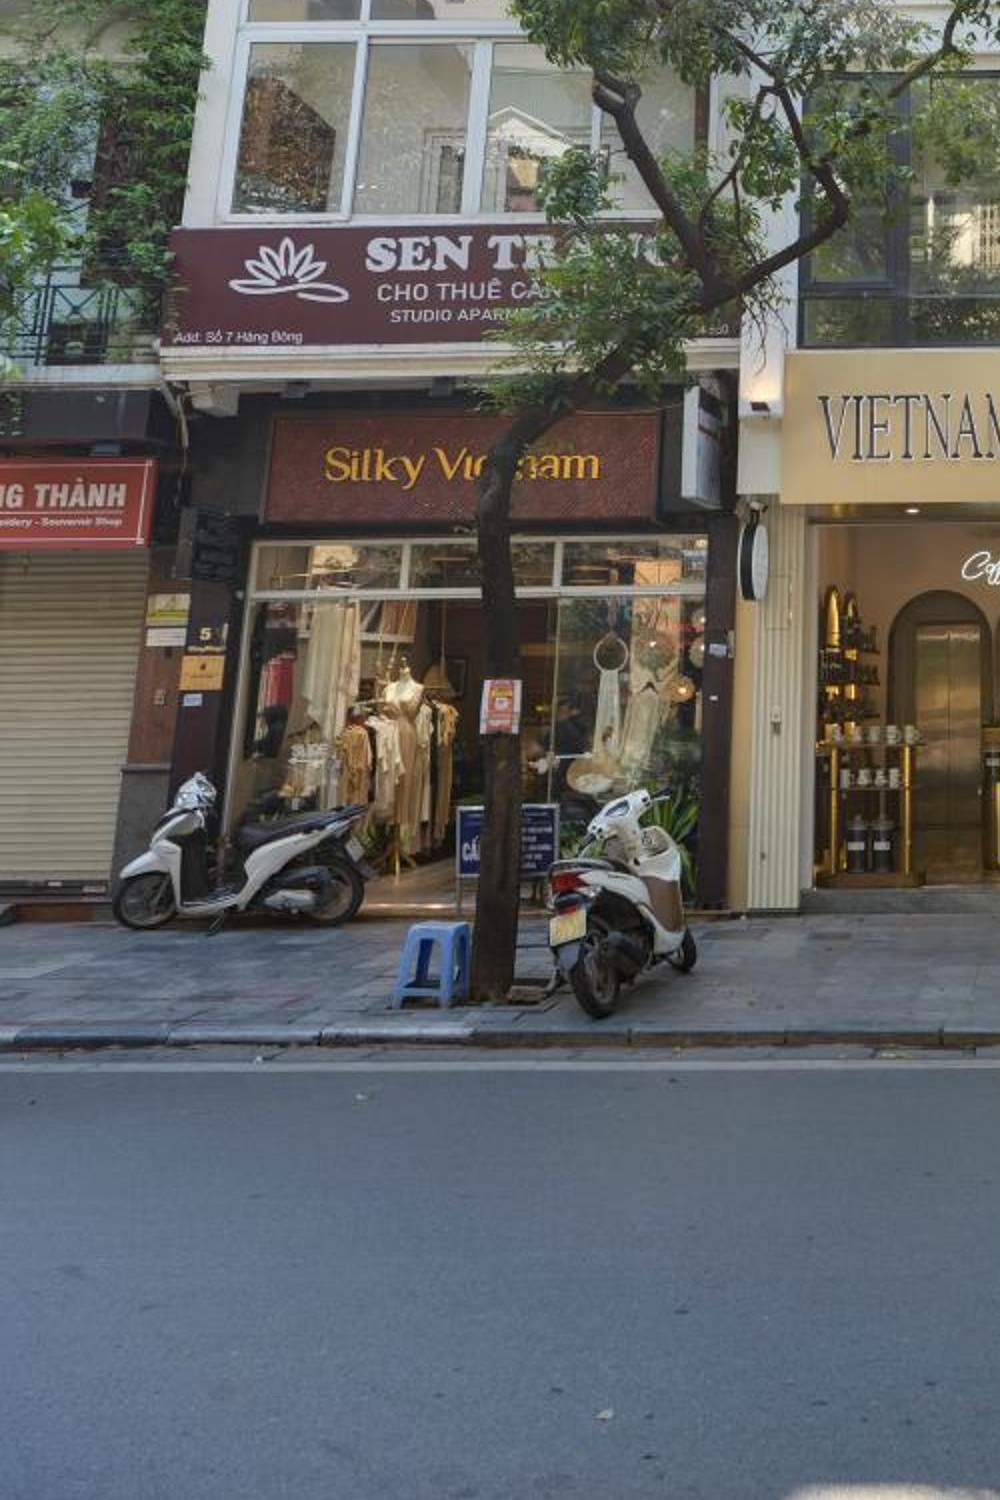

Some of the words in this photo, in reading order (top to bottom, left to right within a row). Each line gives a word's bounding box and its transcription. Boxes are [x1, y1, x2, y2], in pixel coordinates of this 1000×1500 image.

[365, 235, 474, 273] SEN
[377, 283, 428, 301] CHO
[435, 277, 502, 300] THUÊ
[390, 309, 453, 323] STUDIO
[225, 332, 234, 342] 7
[325, 446, 425, 491] Silky
[200, 627, 212, 641] 5
